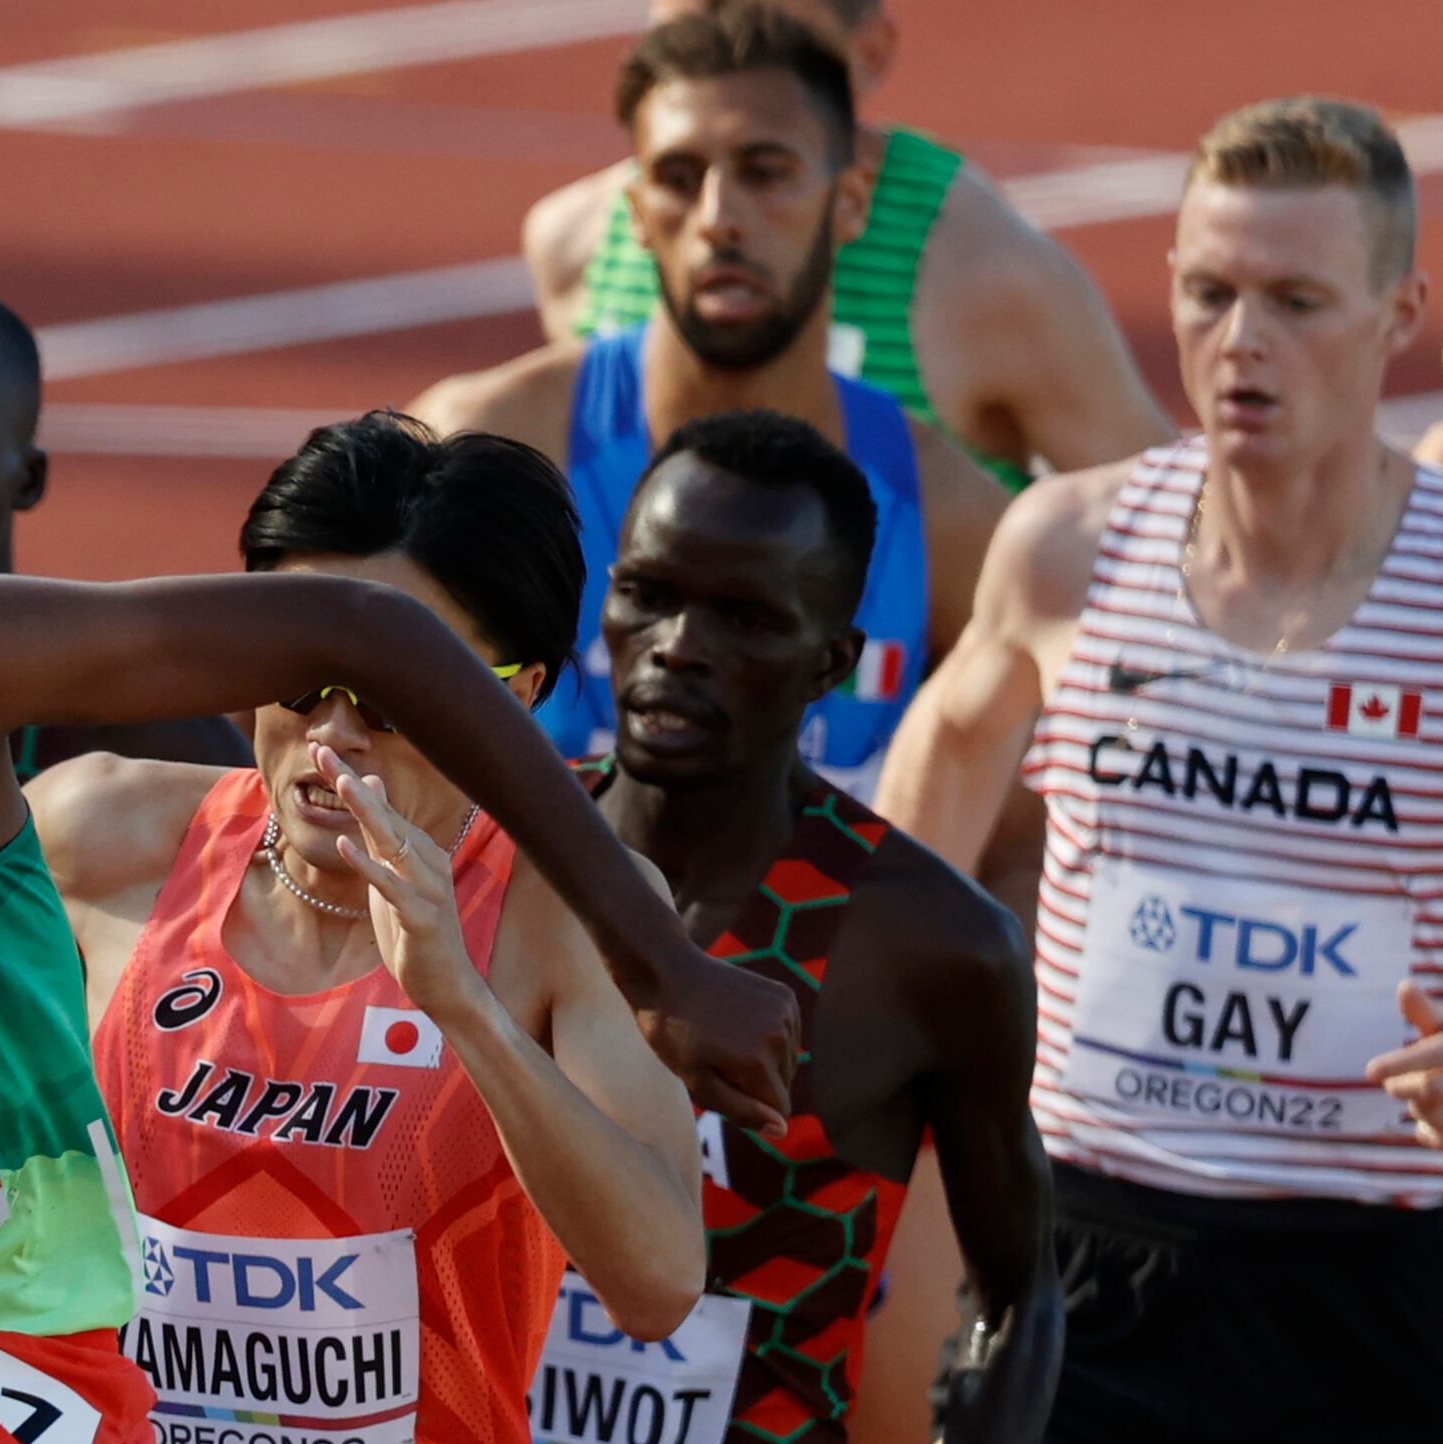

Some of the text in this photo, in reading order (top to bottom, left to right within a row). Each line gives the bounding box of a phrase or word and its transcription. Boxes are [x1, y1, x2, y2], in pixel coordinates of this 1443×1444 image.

[1090, 735, 1398, 833] CANADA
[1180, 907, 1362, 978] TDK
[1162, 981, 1311, 1064] GAY
[155, 1060, 399, 1150] JAPAN
[1114, 1067, 1343, 1129] OREGON22
[173, 1246, 366, 1312] TDK
[118, 1316, 403, 1408] AMAGUCHI
